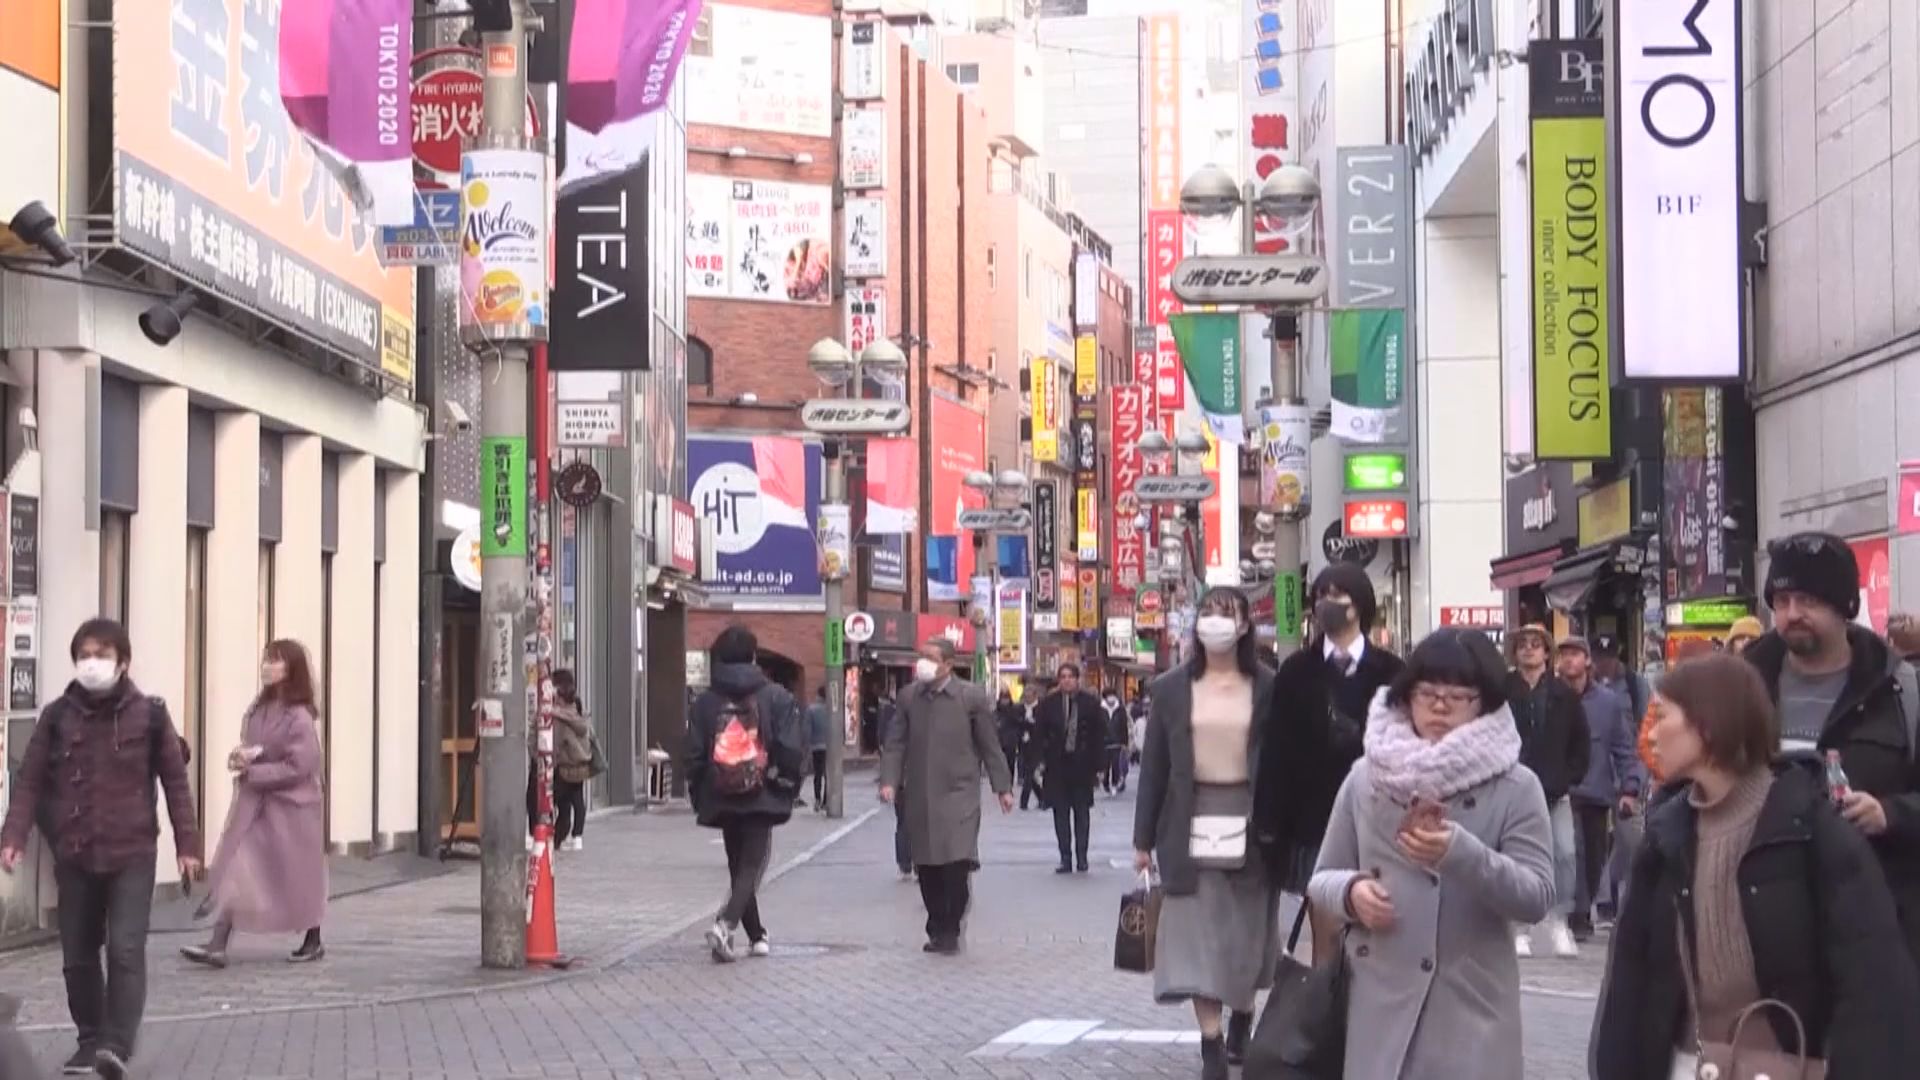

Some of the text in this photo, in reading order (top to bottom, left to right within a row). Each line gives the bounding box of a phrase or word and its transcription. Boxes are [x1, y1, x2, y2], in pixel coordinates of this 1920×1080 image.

[643, 9, 687, 104] TOKYO 2020
[378, 24, 398, 145] TOKYO 2020
[418, 82, 483, 95] FIRE HYDRAN
[1348, 153, 1394, 196] 21
[1657, 195, 1701, 215] BIF
[577, 189, 627, 318] TEA
[1181, 266, 1320, 290] 渋谷センター街
[1541, 219, 1561, 356] inner collection
[1564, 154, 1601, 421] BODY FOCUS
[565, 409, 609, 418] SHIBUYA
[565, 421, 615, 430] HIGHBALL
[1116, 388, 1140, 588] カラオケの歌広場
[717, 569, 793, 585] it-ad.co.jp
